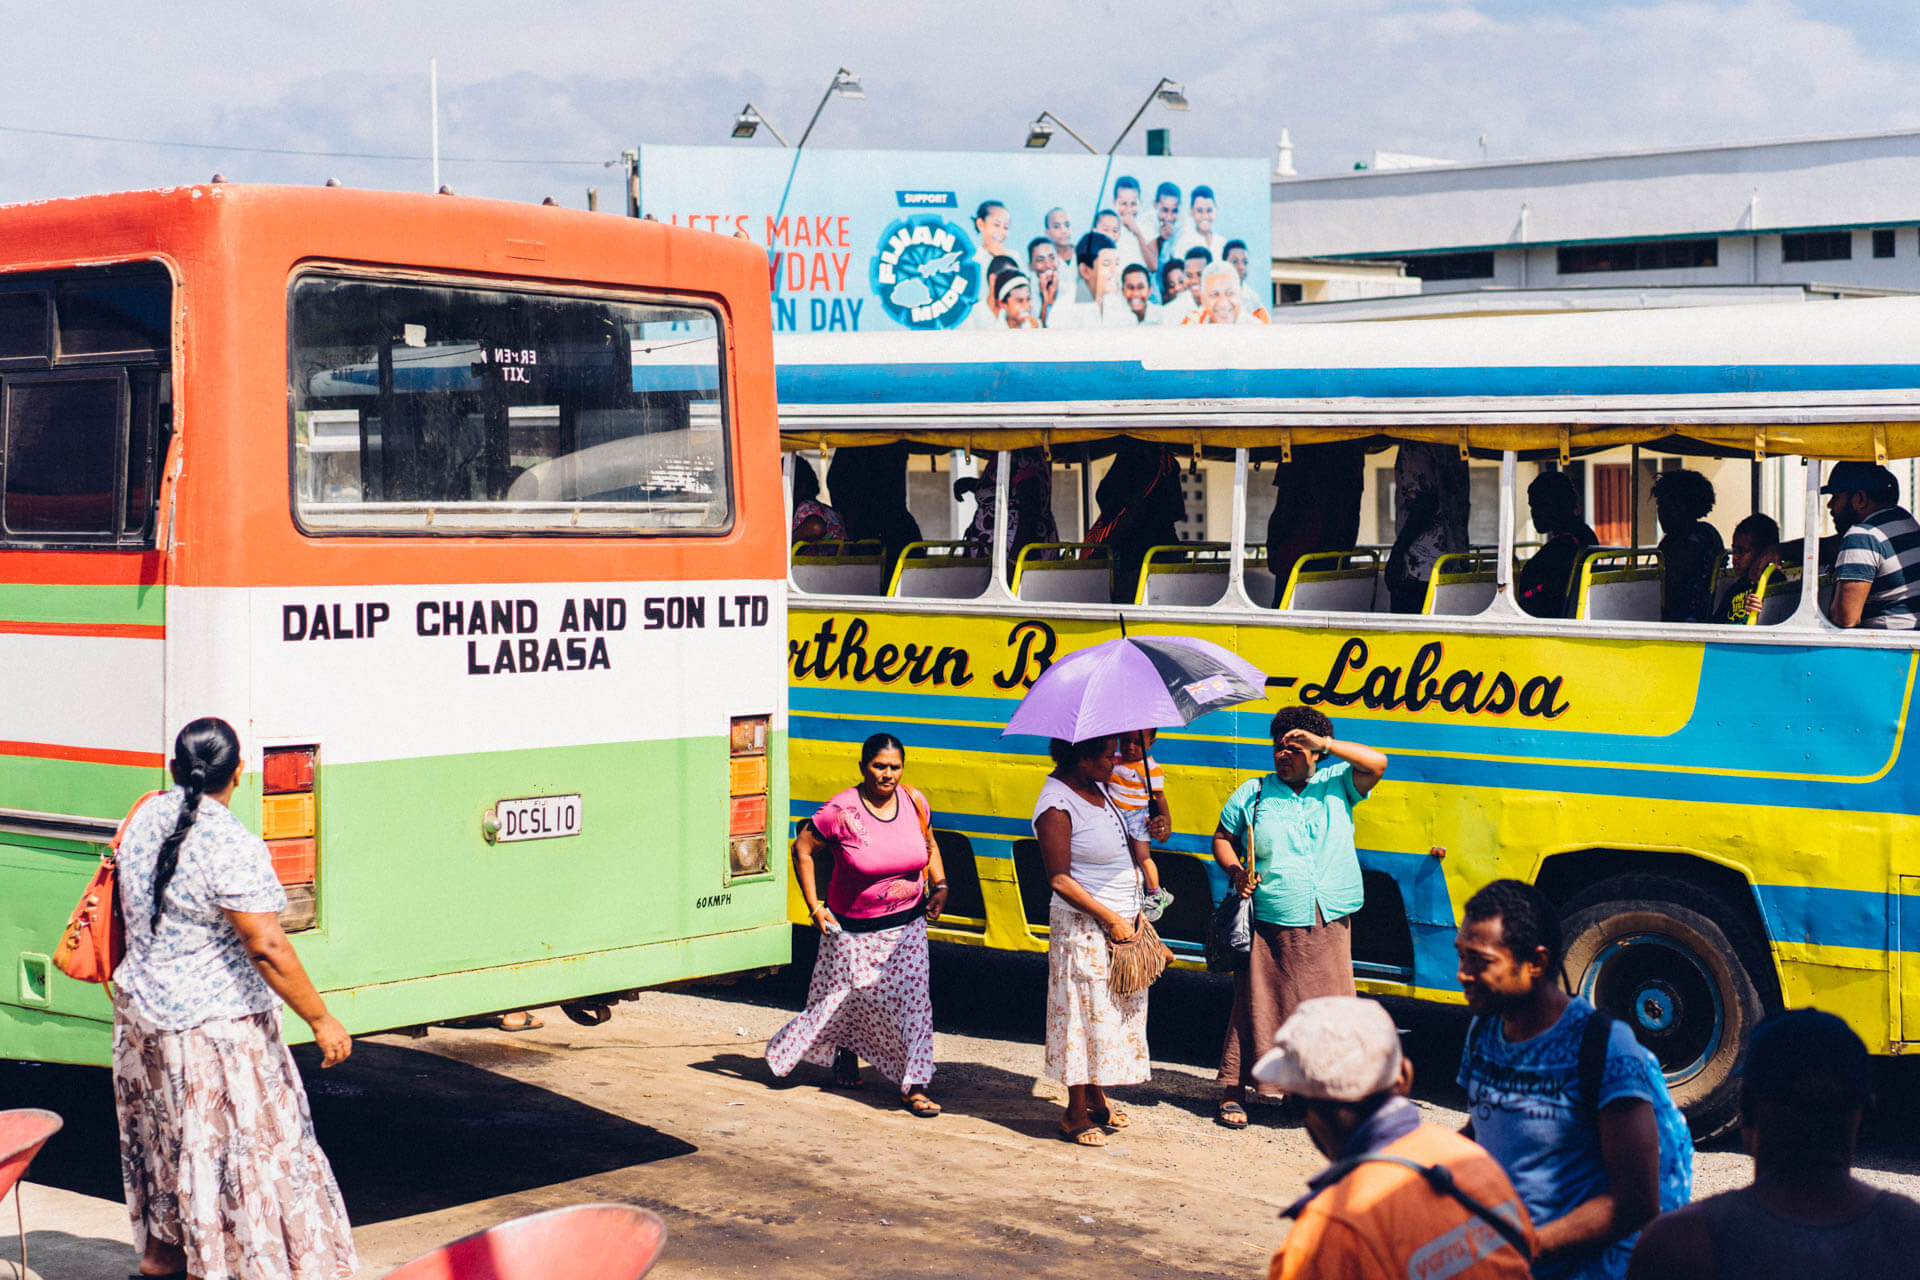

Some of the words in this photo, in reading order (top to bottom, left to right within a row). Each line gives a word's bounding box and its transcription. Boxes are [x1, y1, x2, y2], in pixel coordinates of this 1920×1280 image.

[904, 193, 948, 203] SUPPORT
[766, 216, 850, 247] MAKE
[878, 226, 956, 284] FIJIAN
[811, 298, 864, 332] DAY
[911, 275, 968, 322] MADE
[283, 602, 390, 641] DALIP
[416, 599, 538, 636] CHAND
[560, 598, 626, 632] AND
[644, 596, 705, 630] SON
[718, 596, 769, 627] LTD
[467, 637, 611, 675] LABASA
[506, 805, 575, 835] DCSL10
[696, 893, 732, 909] 60KMPH
